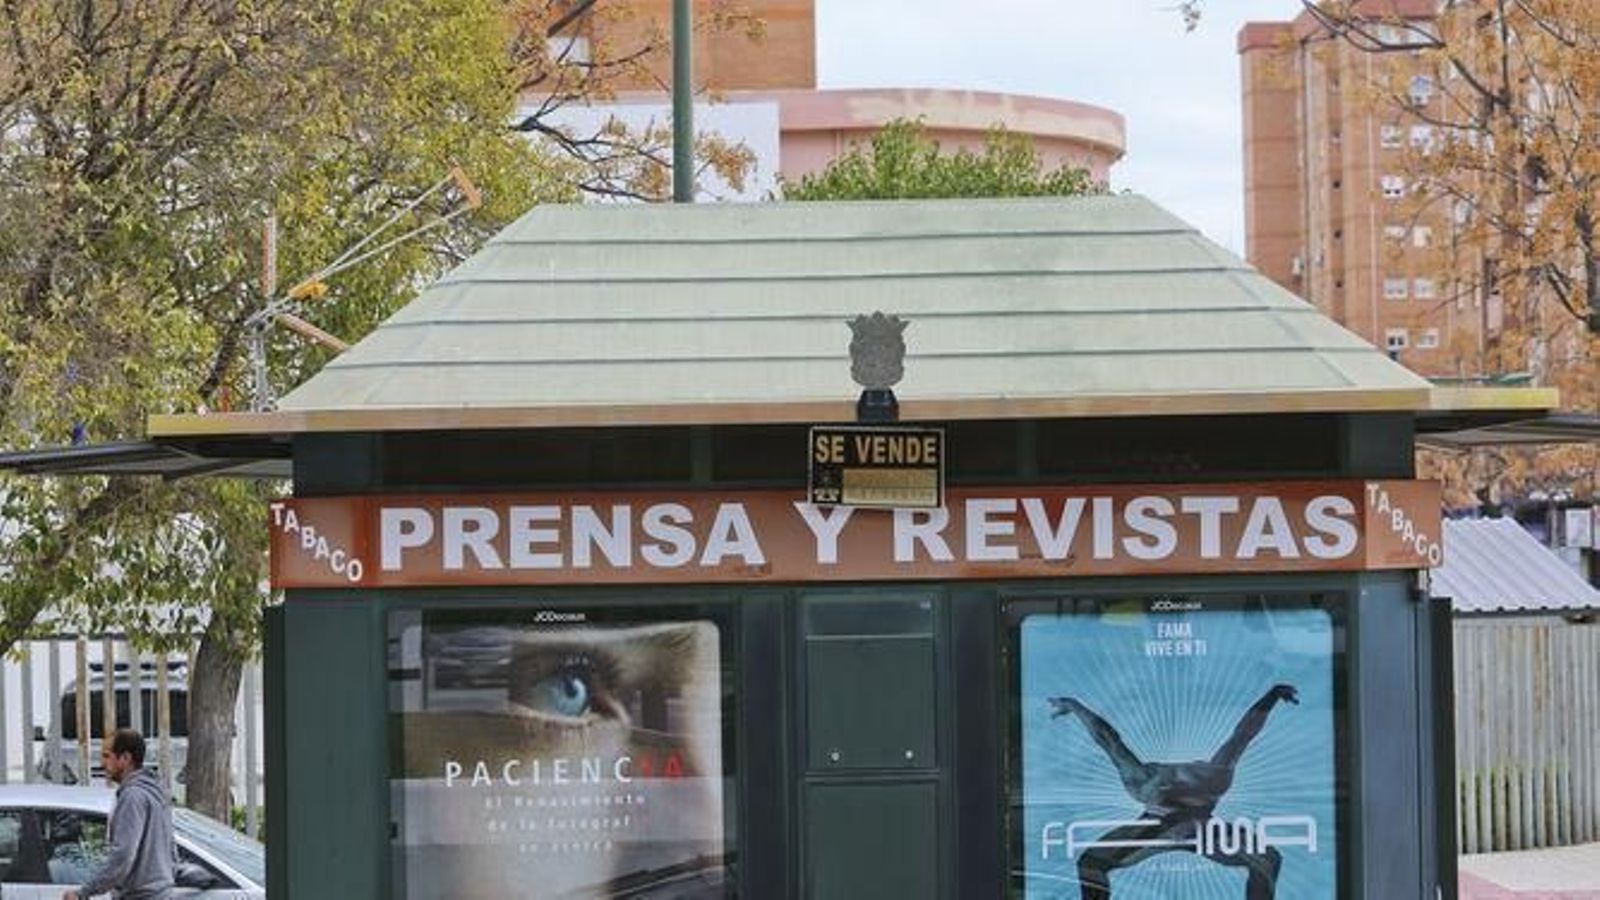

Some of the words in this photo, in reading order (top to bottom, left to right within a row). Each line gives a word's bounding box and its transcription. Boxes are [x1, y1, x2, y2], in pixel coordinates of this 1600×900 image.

[814, 435, 845, 463] SE
[855, 435, 938, 464] VENDE
[380, 502, 766, 571] PRENSA
[793, 501, 856, 566] Y
[893, 494, 1360, 563] REVISTAS
[1366, 483, 1440, 566] TABACO
[270, 503, 363, 582] TABACO
[1157, 622, 1193, 638] FAMA
[1145, 640, 1173, 657] VIVE
[445, 752, 684, 787] PACIENCIA
